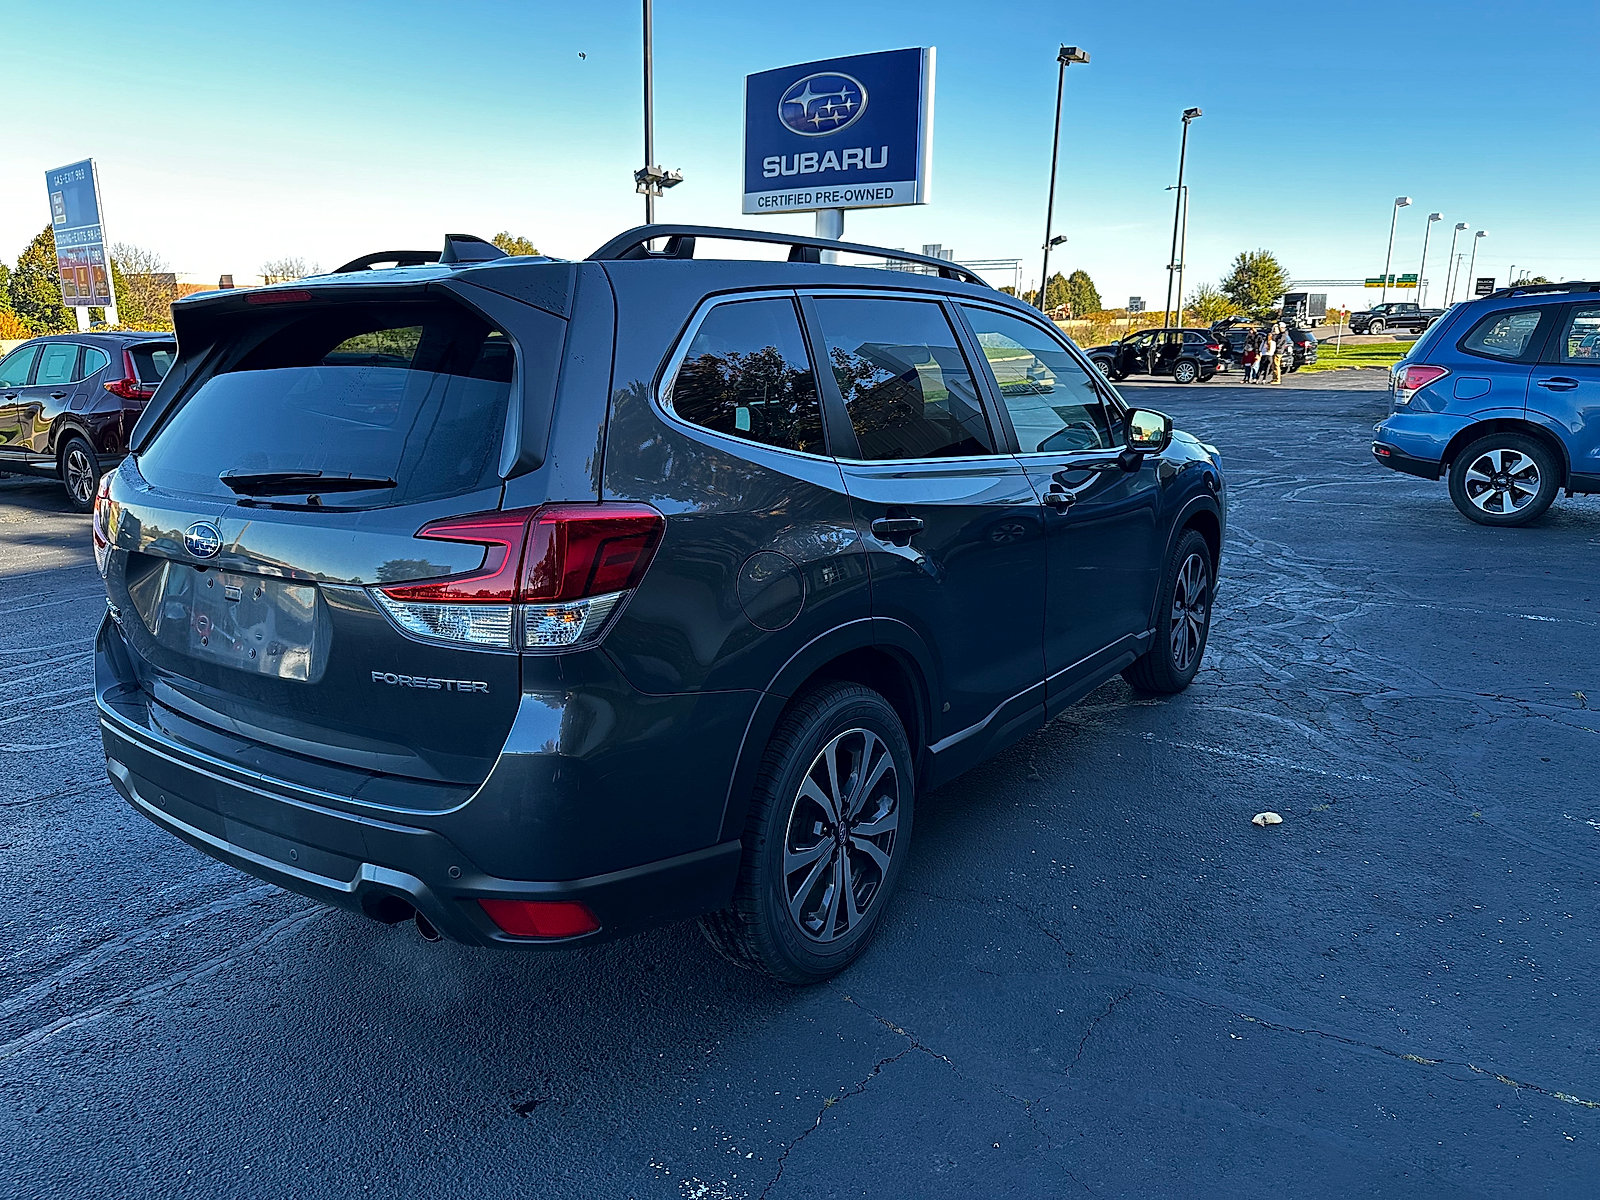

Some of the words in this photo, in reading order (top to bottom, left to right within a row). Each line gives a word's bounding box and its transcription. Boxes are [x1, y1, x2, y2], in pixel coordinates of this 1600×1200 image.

[762, 146, 889, 178] SUBARU
[757, 192, 812, 207] CERTIFIED
[815, 187, 894, 204] PRE-OWNED
[371, 670, 490, 694] FORESTER
